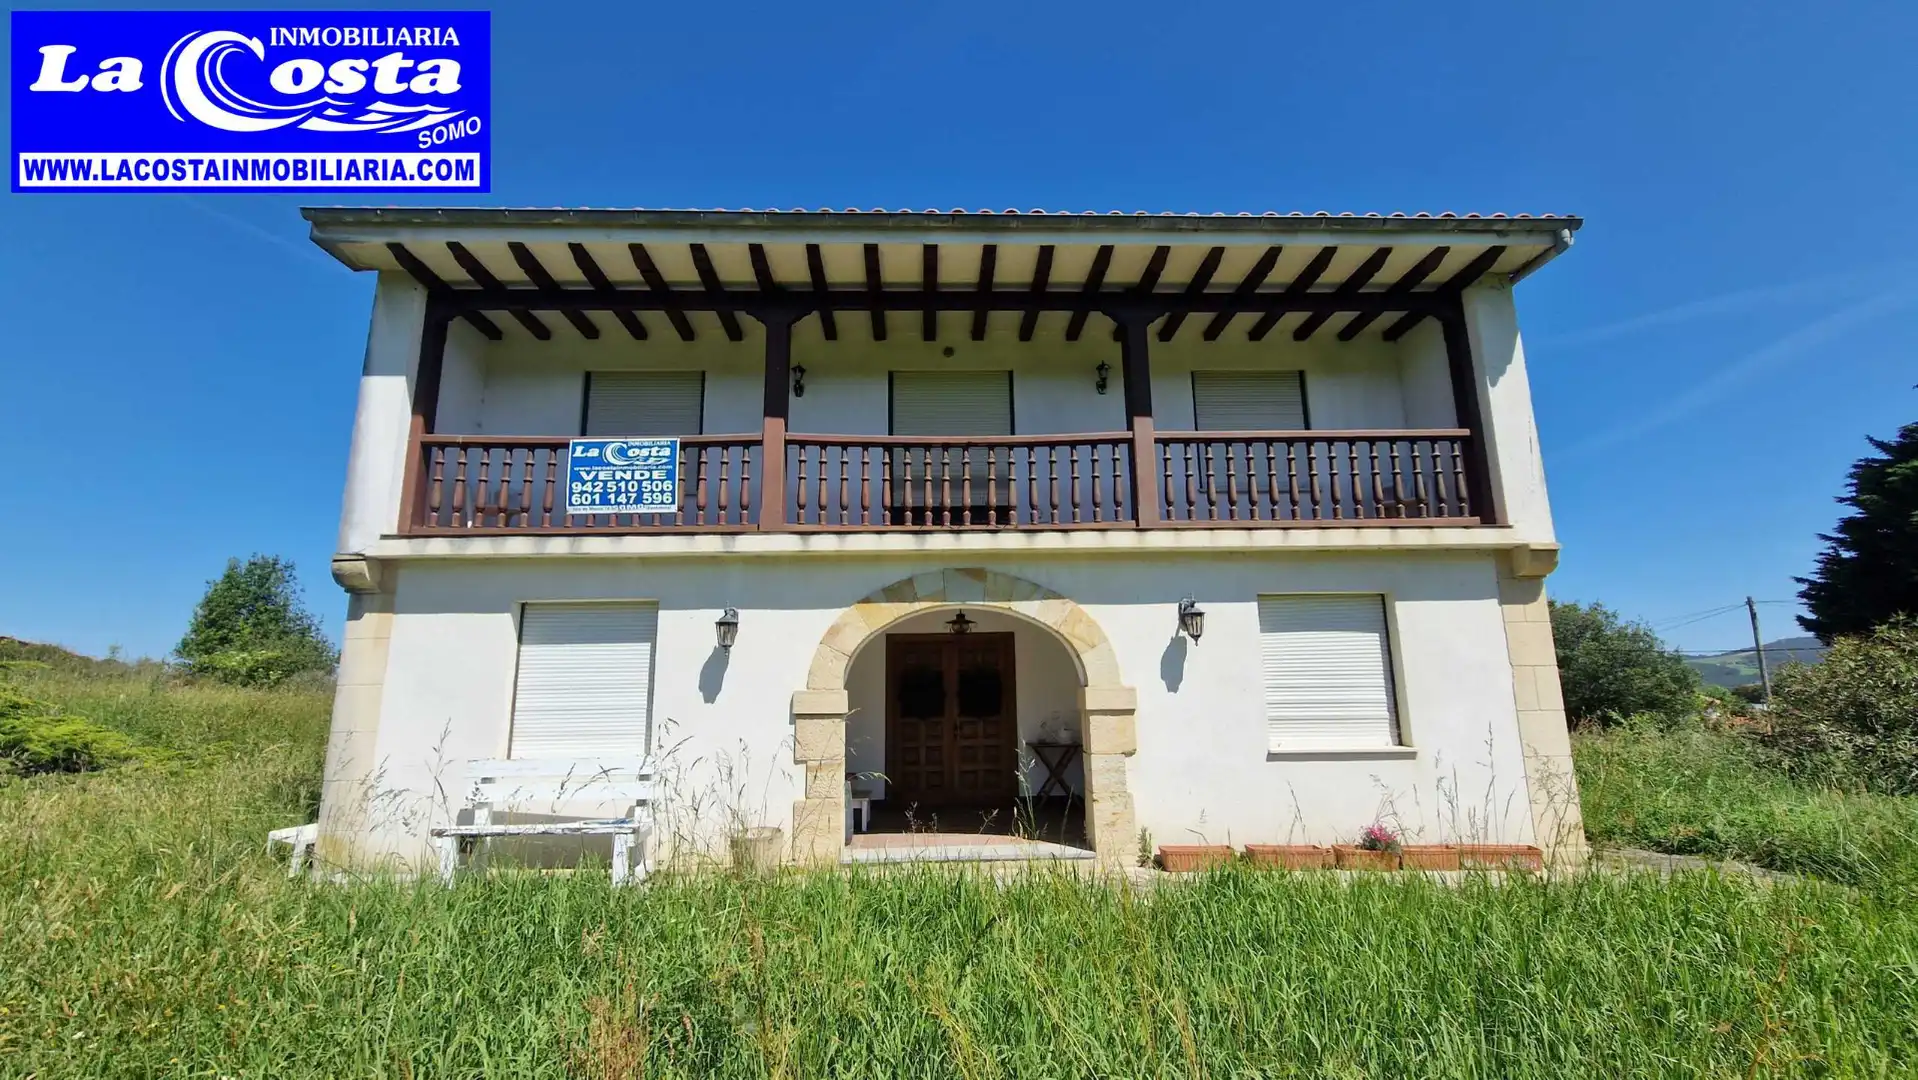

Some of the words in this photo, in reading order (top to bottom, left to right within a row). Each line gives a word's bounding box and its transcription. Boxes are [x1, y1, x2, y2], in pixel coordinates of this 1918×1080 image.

[572, 445, 600, 457] La
[602, 442, 671, 466] Costa
[579, 470, 667, 480] VENDE
[571, 481, 604, 493] 942
[606, 481, 639, 492] 510
[641, 480, 673, 492] 506
[571, 493, 600, 505] 601
[607, 492, 637, 504] 147
[642, 492, 673, 504] 596
